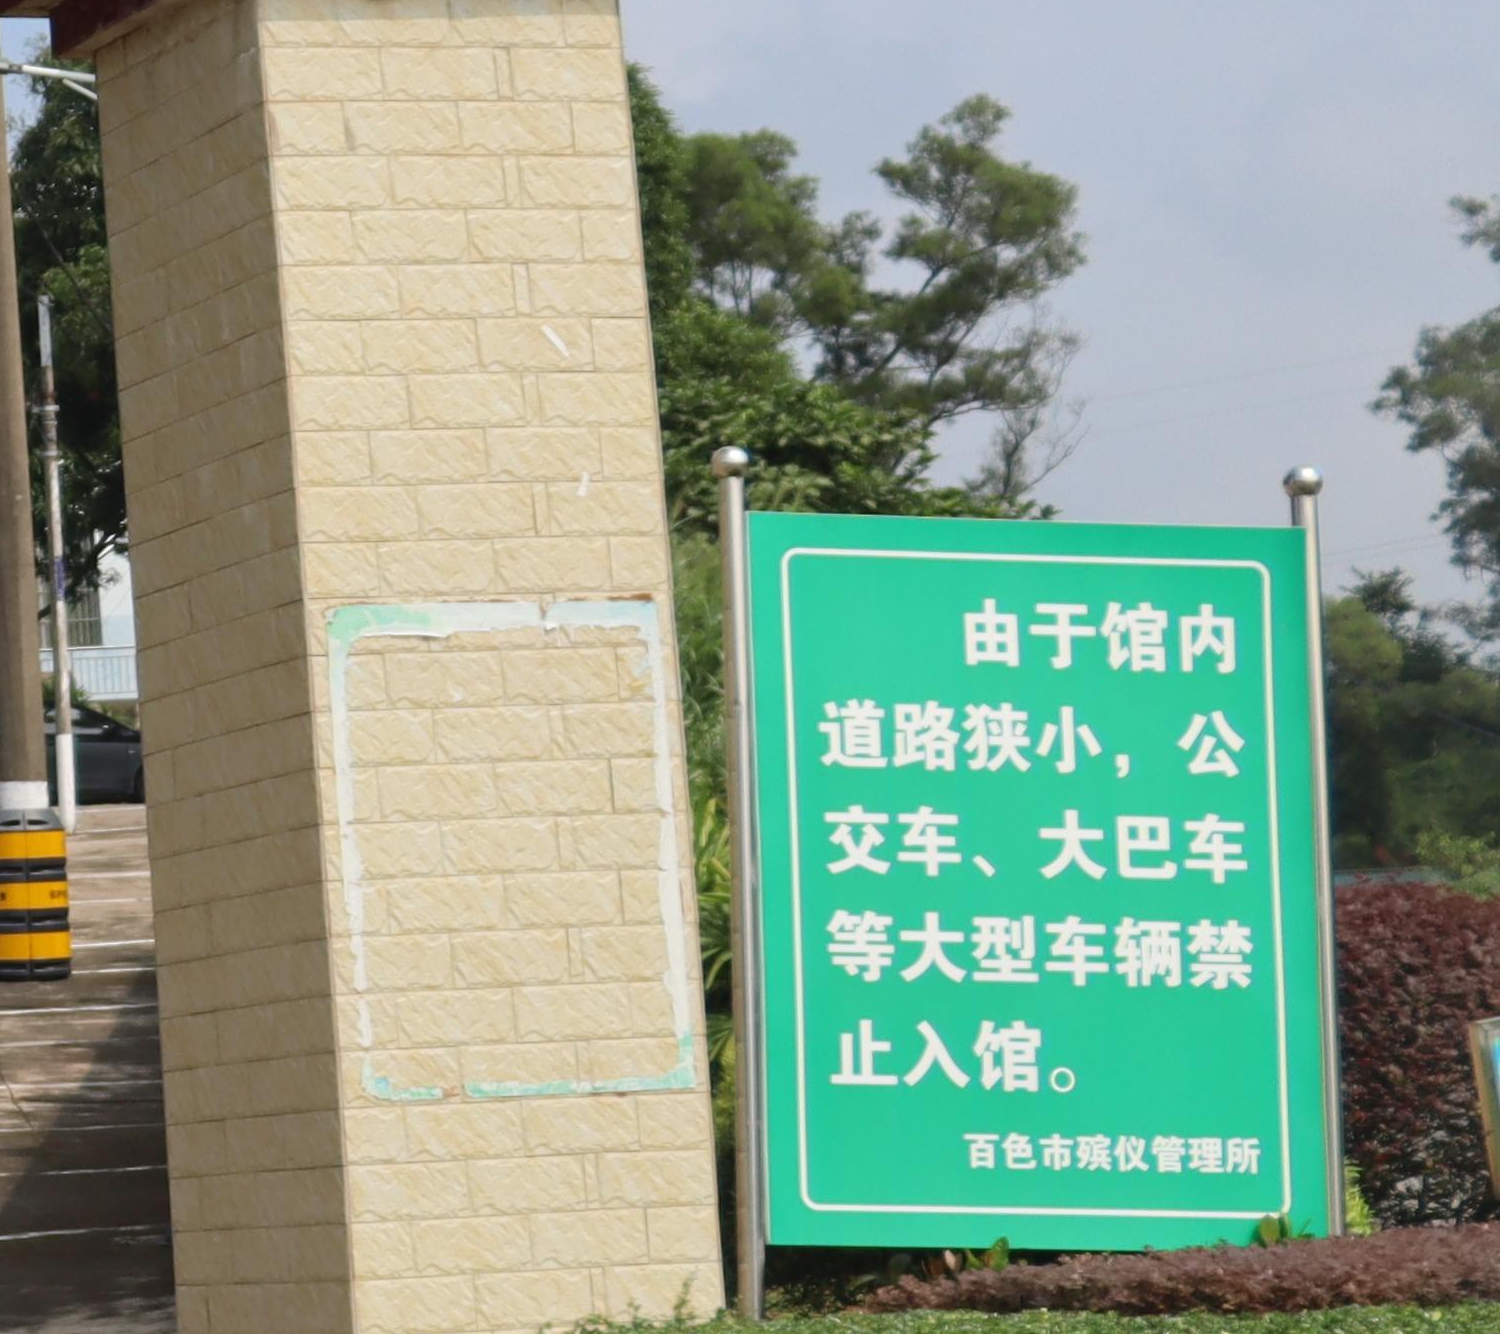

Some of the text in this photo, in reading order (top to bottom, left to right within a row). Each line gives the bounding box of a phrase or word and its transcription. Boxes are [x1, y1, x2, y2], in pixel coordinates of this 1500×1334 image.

[963, 598, 1236, 675] 由于馆内
[817, 699, 1246, 779] 道路狭小，公
[823, 804, 1249, 884] 交车、大巴车
[827, 910, 1255, 989] 等大型车辆禁
[830, 1019, 1076, 1093] 止入馆。
[963, 1131, 1262, 1175] 百色市殡仪管理所
